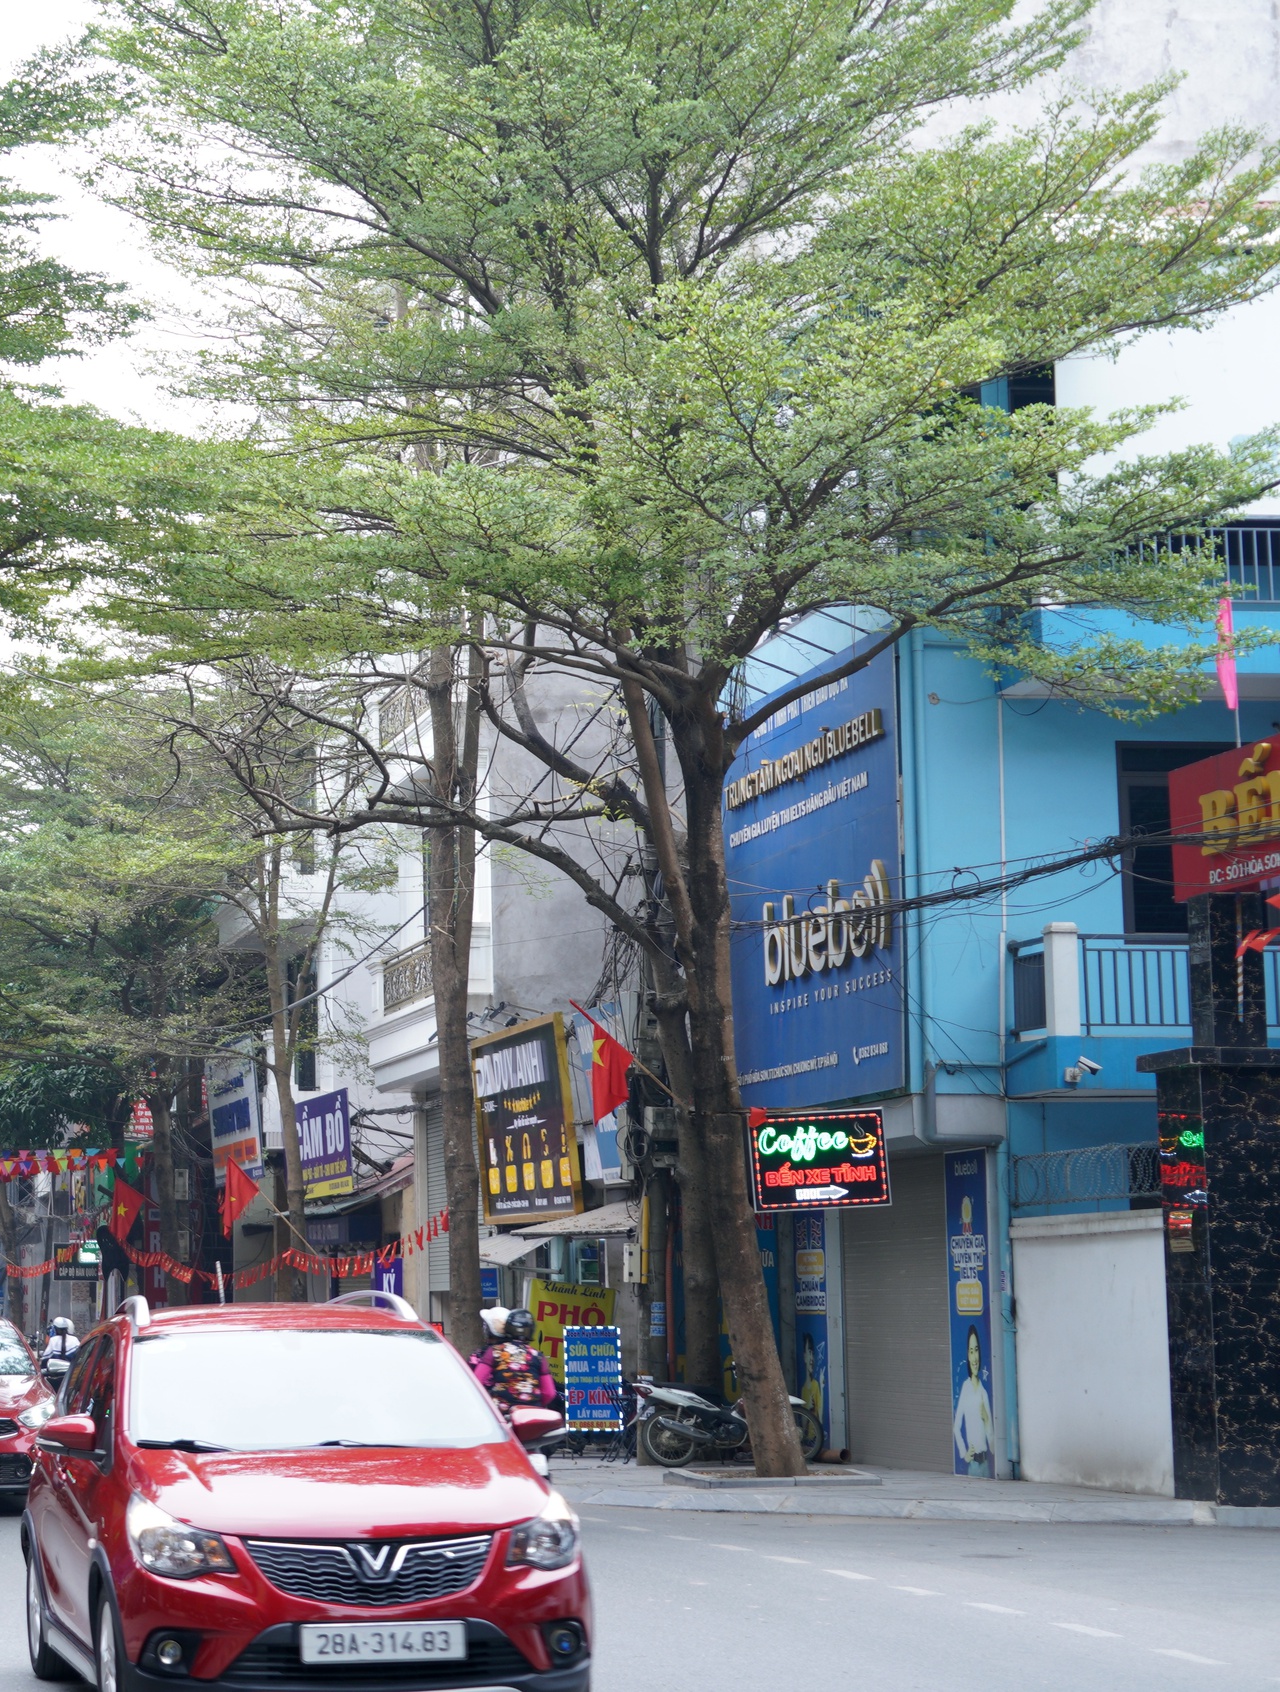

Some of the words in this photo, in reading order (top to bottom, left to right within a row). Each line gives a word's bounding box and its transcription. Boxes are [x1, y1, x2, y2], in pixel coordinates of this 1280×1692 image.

[724, 774, 754, 809] TRUNG
[826, 709, 883, 758] BLUEBELL
[851, 771, 869, 793] NAM
[1209, 869, 1225, 884] ĐC:
[1226, 858, 1239, 880] SỐ
[1244, 856, 1264, 876] HÒA
[763, 859, 891, 987] bluebell
[770, 993, 809, 1016] INSPIRE
[814, 984, 839, 1002] YOUR
[845, 968, 893, 993] SUCCESS
[516, 1040, 544, 1087] ANH
[325, 1095, 345, 1155] ĐỒ
[758, 1125, 849, 1162] Coffee
[765, 1162, 805, 1187] BẾN
[805, 1168, 830, 1185] XE
[952, 1235, 973, 1249] CHUYÊN
[974, 1237, 985, 1248] GIA
[954, 1251, 972, 1266] LUYỆN
[973, 1252, 982, 1263] THI
[960, 1266, 977, 1279] IELTS
[540, 1280, 577, 1295] Khánh
[581, 1287, 606, 1299] Linh
[796, 1295, 825, 1307] CAMBRIDGE
[569, 1341, 588, 1357] SỬA
[590, 1342, 616, 1357] CHỮA
[568, 1361, 589, 1373] MUA
[598, 1358, 618, 1373] BÁN
[569, 1387, 585, 1406] ÉP
[577, 1407, 590, 1418] LẤY
[592, 1409, 611, 1418] NGAY
[316, 1630, 451, 1656] 28A-314.83
